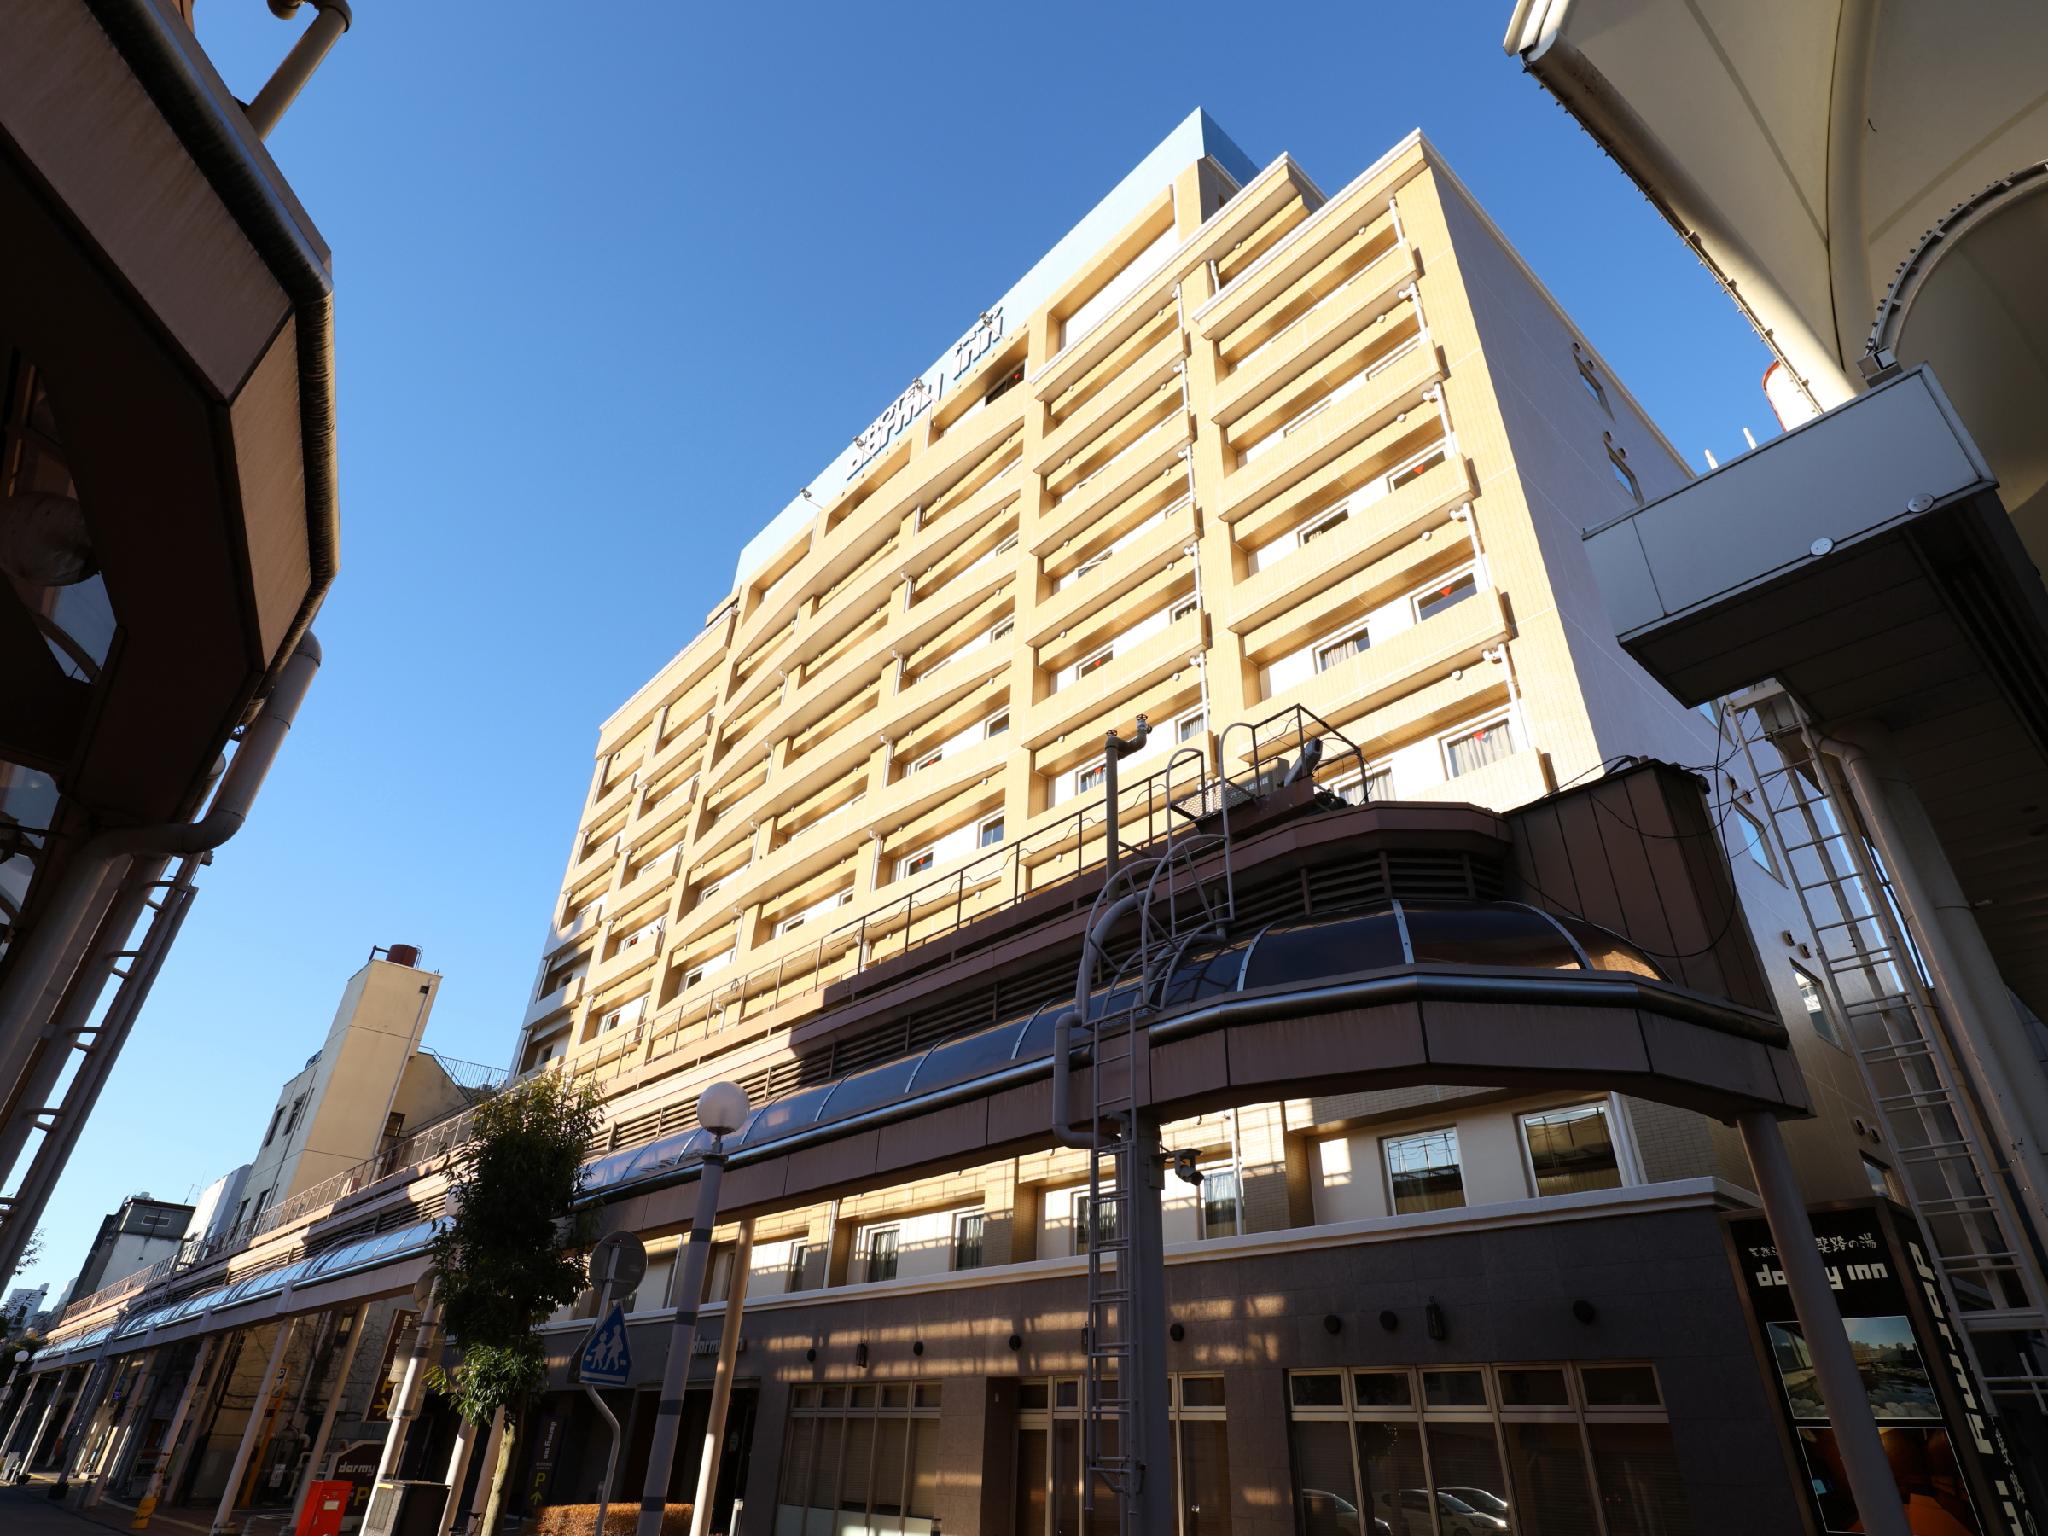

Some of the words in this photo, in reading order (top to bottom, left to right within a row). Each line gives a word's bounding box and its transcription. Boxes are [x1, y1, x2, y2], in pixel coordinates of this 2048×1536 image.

[1755, 1263, 1844, 1290] doy
[1846, 1263, 1889, 1281] inn
[1908, 1241, 1994, 1455] dormy
[1995, 1480, 2025, 1536] in
[338, 1461, 376, 1476] dormy
[534, 1472, 547, 1488] P
